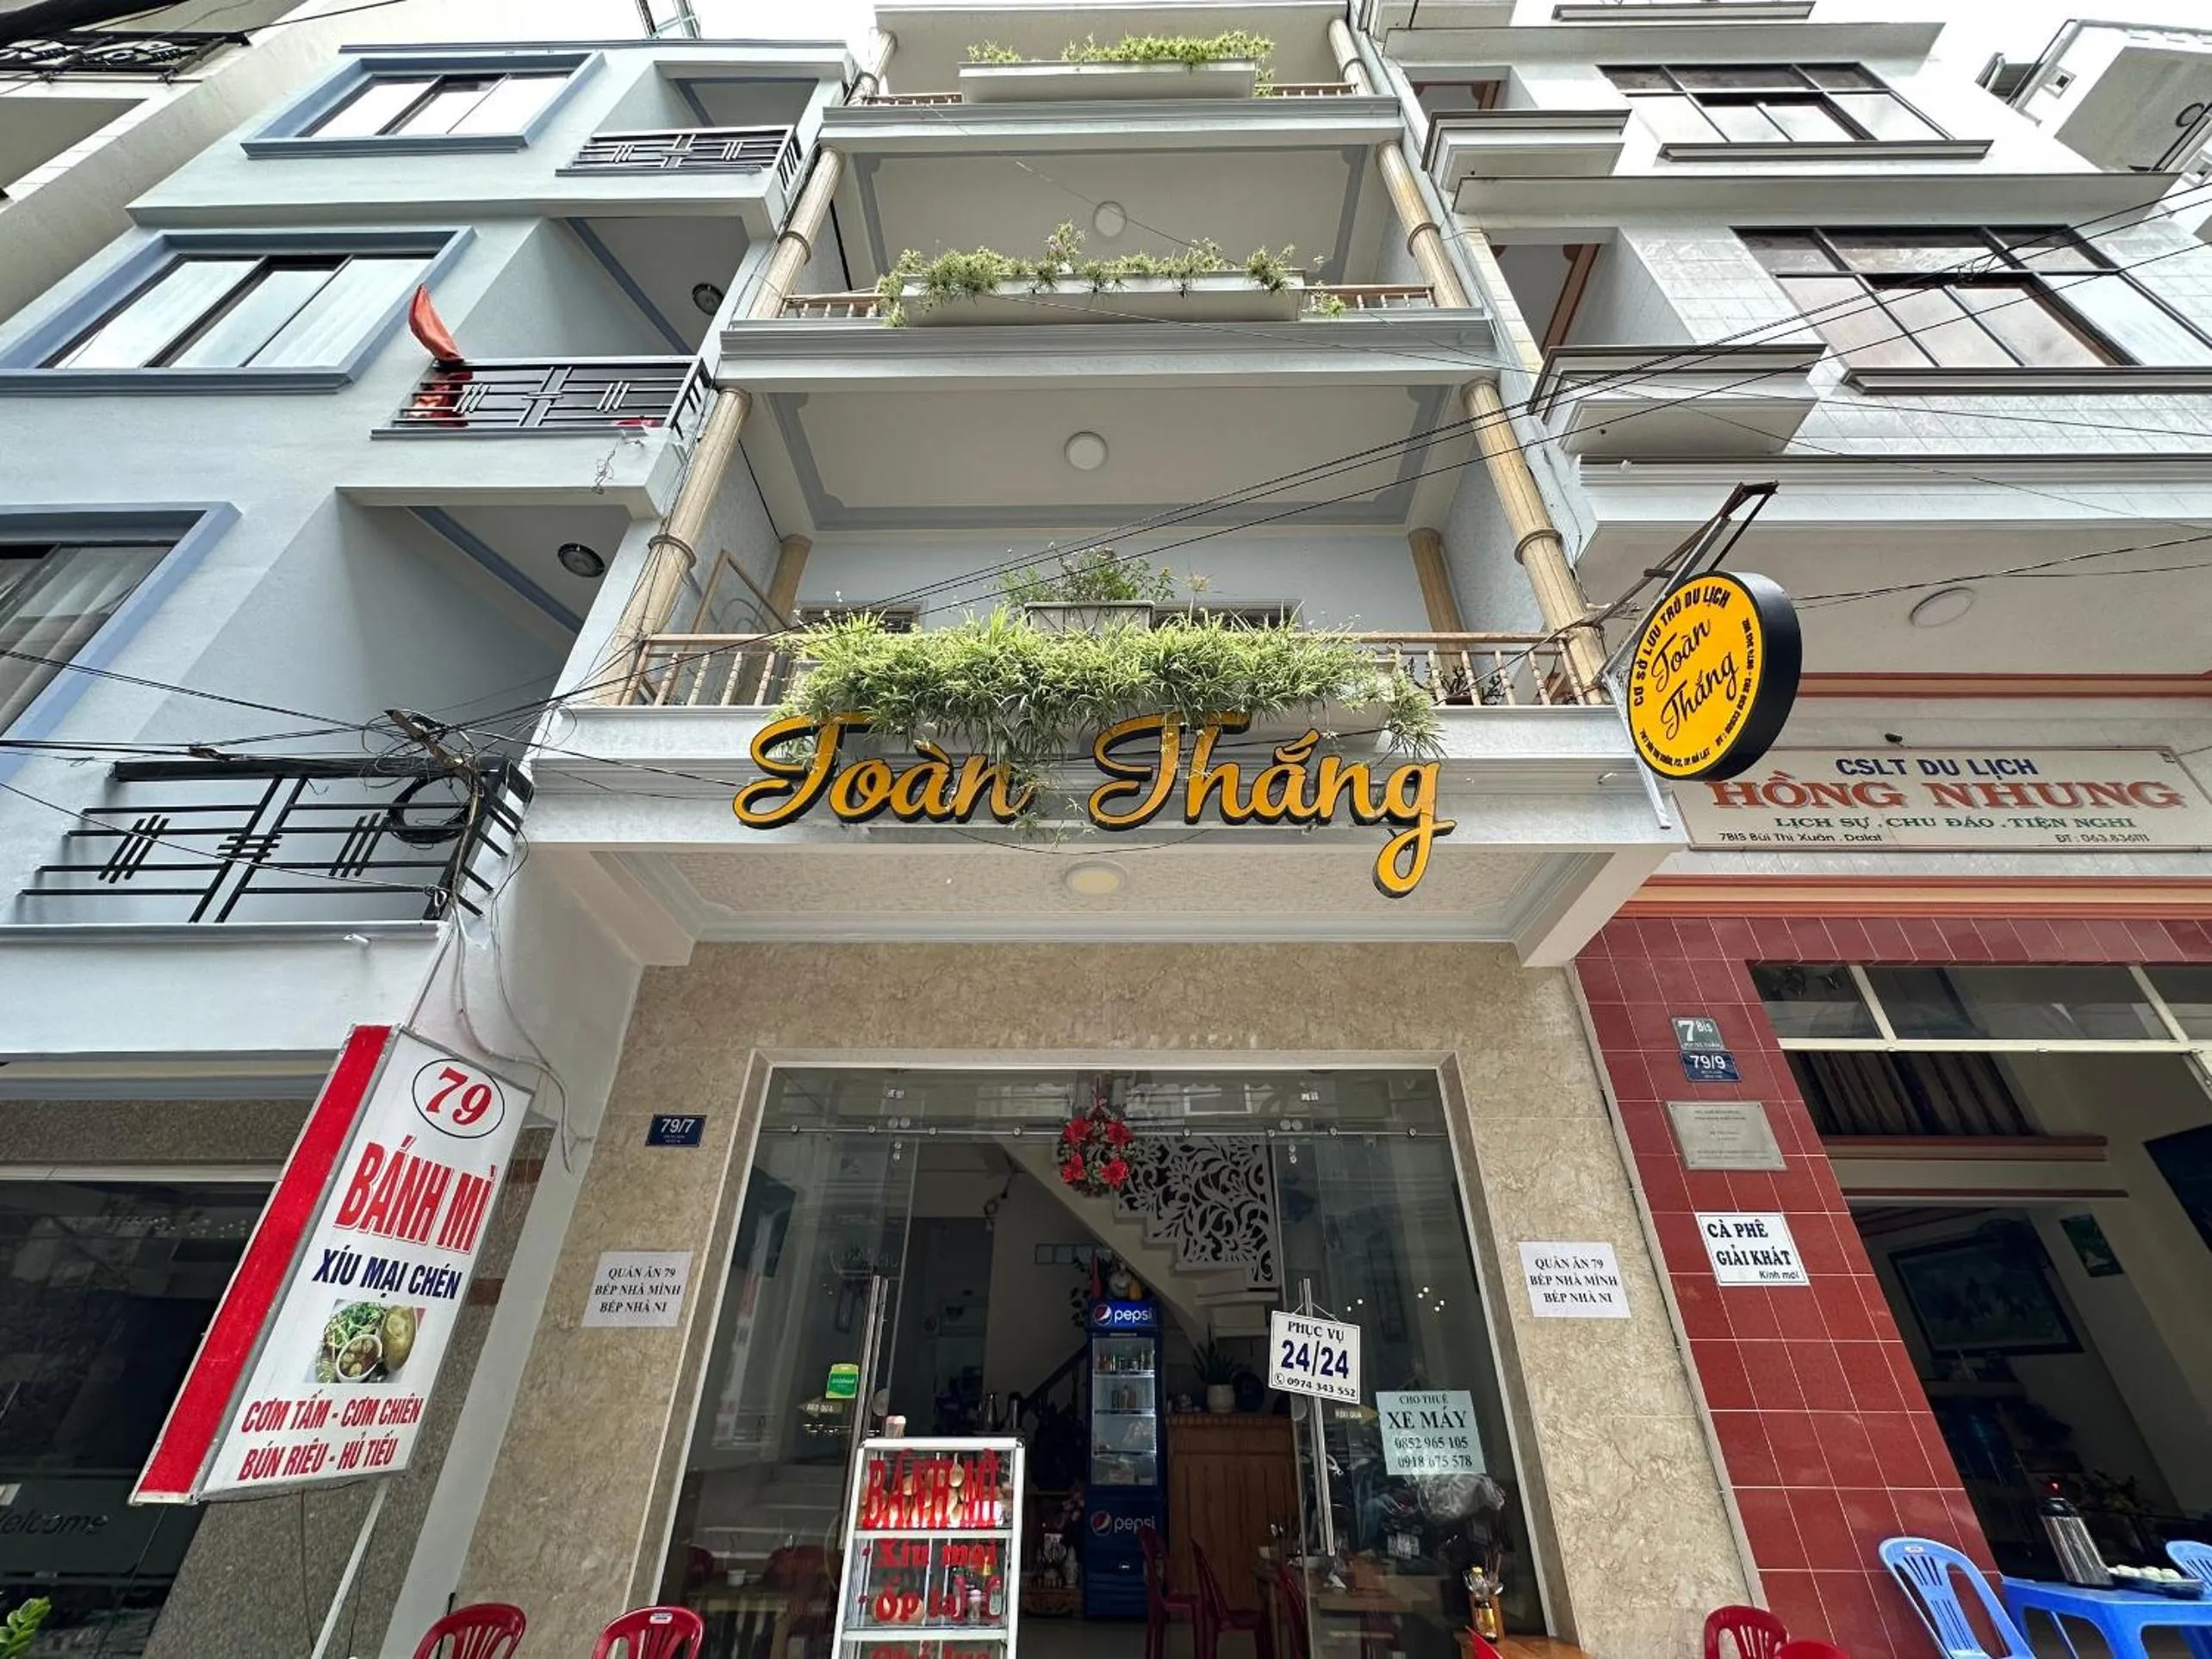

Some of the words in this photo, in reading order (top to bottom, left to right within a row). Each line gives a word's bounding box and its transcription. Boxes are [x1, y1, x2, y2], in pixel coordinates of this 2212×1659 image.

[1684, 587, 1700, 609] DU
[1702, 585, 1731, 610] LỊCH
[1651, 618, 1711, 693] Toàn
[1661, 651, 1739, 741] Thắng
[1836, 759, 1908, 776] CSLT
[1917, 758, 1961, 776] DU
[1966, 758, 2039, 780] LỊCH
[1704, 769, 1905, 808] HỒNG
[1921, 780, 2185, 809] NHUNG
[732, 710, 1033, 829] Toàn
[1088, 711, 1457, 898] Thắng
[1774, 817, 1835, 830] LỊCH
[1841, 817, 1869, 830] SỰ
[2075, 817, 2137, 829] NGHI
[1689, 1055, 1726, 1069] 79/9
[426, 1066, 493, 1126] 79
[661, 1118, 695, 1134] 79/7
[333, 1134, 454, 1245] BÁNH
[436, 1165, 496, 1254] MÌ
[1707, 1220, 1731, 1238] CÀ
[1733, 1219, 1768, 1238] PHÊ
[1591, 1258, 1604, 1269] 79
[1749, 1246, 1791, 1265] KHÁT
[312, 1245, 362, 1285] XÍU
[360, 1257, 408, 1298] MẠI
[408, 1264, 463, 1299] CHÉN
[664, 1268, 675, 1277] 79
[1599, 1293, 1612, 1302] NI
[1115, 1308, 1153, 1323] pepsi
[1289, 1321, 1322, 1338] PHỤC
[1327, 1328, 1344, 1344] VỤ
[1281, 1339, 1349, 1379] 24/24
[1287, 1377, 1312, 1389] 0974
[1316, 1382, 1334, 1393] 343
[1337, 1386, 1356, 1396] 552
[241, 1397, 292, 1432] CƠM
[289, 1389, 332, 1430] TẤM
[340, 1396, 382, 1427] CƠM
[379, 1393, 424, 1424] CHIÊN
[1387, 1411, 1414, 1429] XE
[1420, 1405, 1467, 1429] MÁY
[1395, 1437, 1421, 1449] 0852
[1424, 1437, 1445, 1449] 965
[1449, 1436, 1468, 1449] 105
[237, 1440, 286, 1481] BÚN
[282, 1438, 329, 1476] RIÊU
[336, 1431, 365, 1470] HỦ
[363, 1430, 399, 1467] TIẾU
[1452, 1455, 1472, 1467] 578
[0, 1508, 108, 1535] elcome
[1115, 1516, 1155, 1534] pepsi
